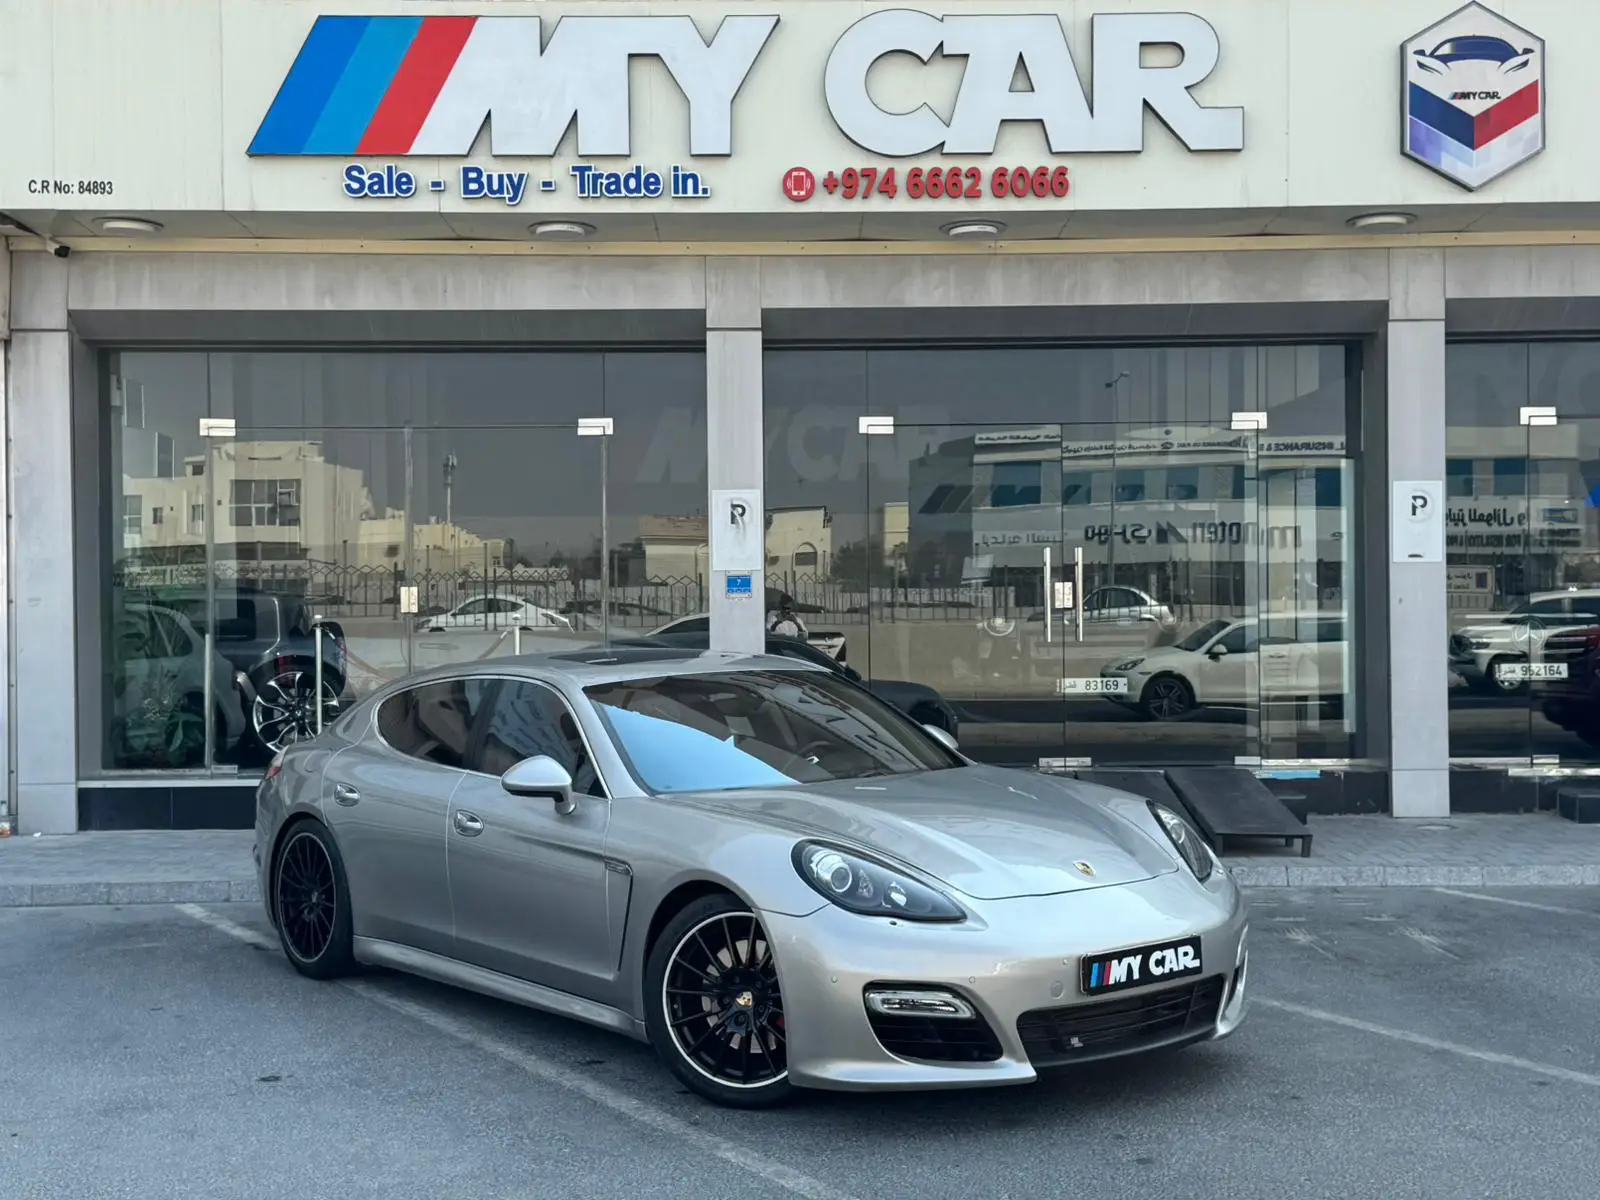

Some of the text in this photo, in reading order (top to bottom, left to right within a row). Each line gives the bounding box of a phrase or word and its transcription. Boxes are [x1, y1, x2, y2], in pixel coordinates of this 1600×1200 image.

[408, 9, 1245, 157] MY CAR
[1459, 91, 1501, 100] MY CAR
[28, 179, 113, 195] C.R No: 84893
[343, 163, 416, 198] Sale
[460, 165, 528, 205] Buy
[570, 163, 664, 198] Trade
[671, 164, 711, 198] in.
[822, 165, 1070, 199] +974 6662 6066
[1084, 679, 1119, 691] 83169
[1108, 944, 1201, 985] MY CAR
